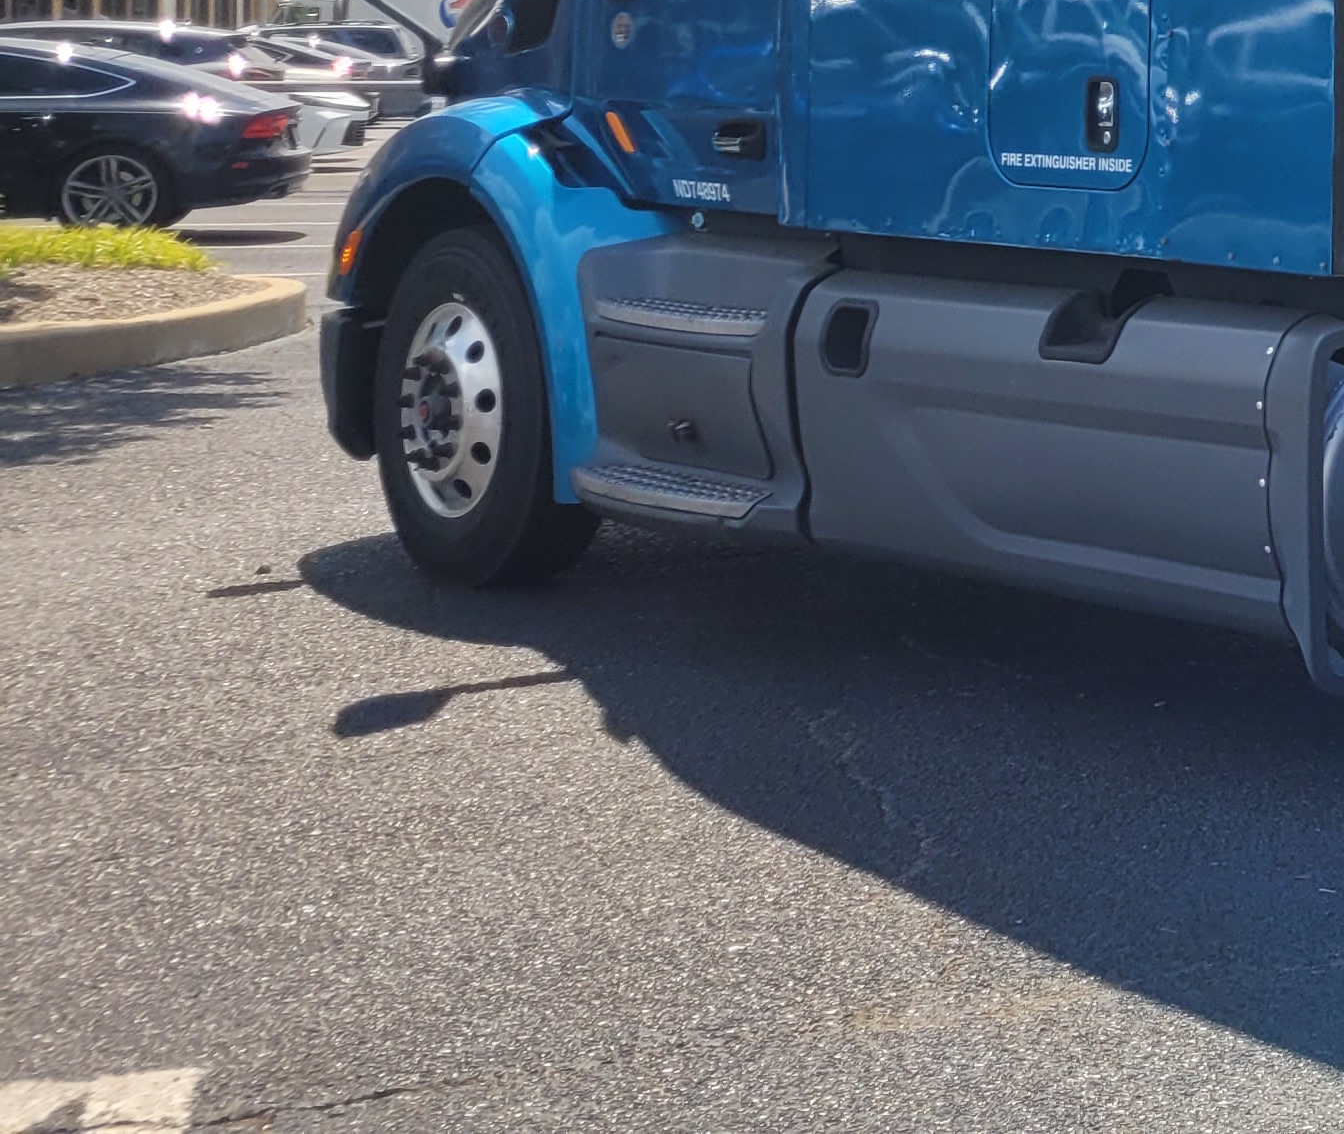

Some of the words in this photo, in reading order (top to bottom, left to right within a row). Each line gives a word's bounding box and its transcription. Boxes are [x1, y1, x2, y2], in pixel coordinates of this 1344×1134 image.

[1001, 153, 1023, 167] FIRE
[1024, 153, 1096, 171] EXTINGUISHER
[1098, 157, 1133, 173] INSIDE
